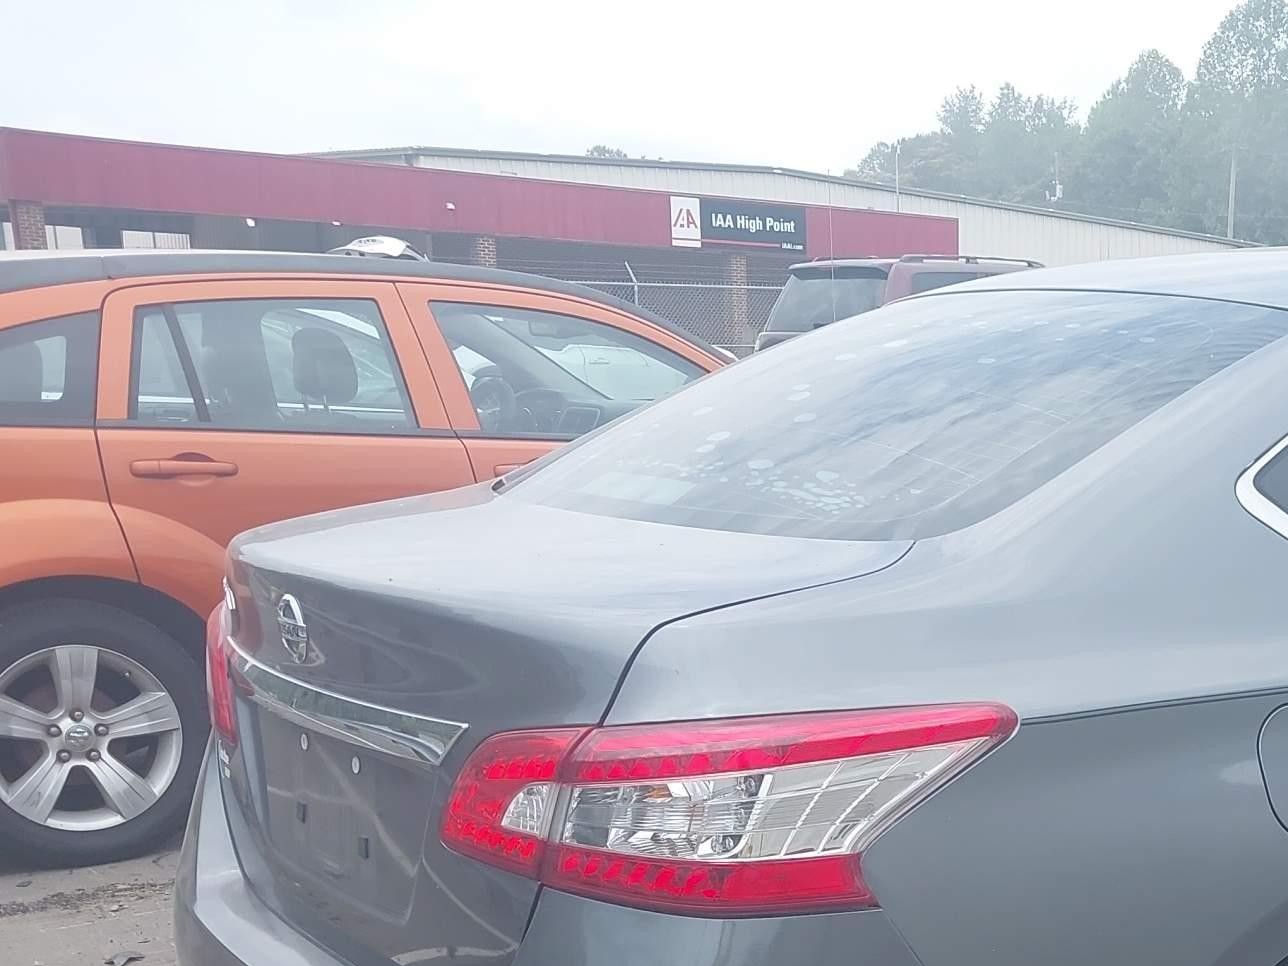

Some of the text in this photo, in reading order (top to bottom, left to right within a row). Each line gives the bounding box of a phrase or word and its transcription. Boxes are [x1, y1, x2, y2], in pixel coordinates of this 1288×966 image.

[711, 213, 795, 233] IAA High Point
